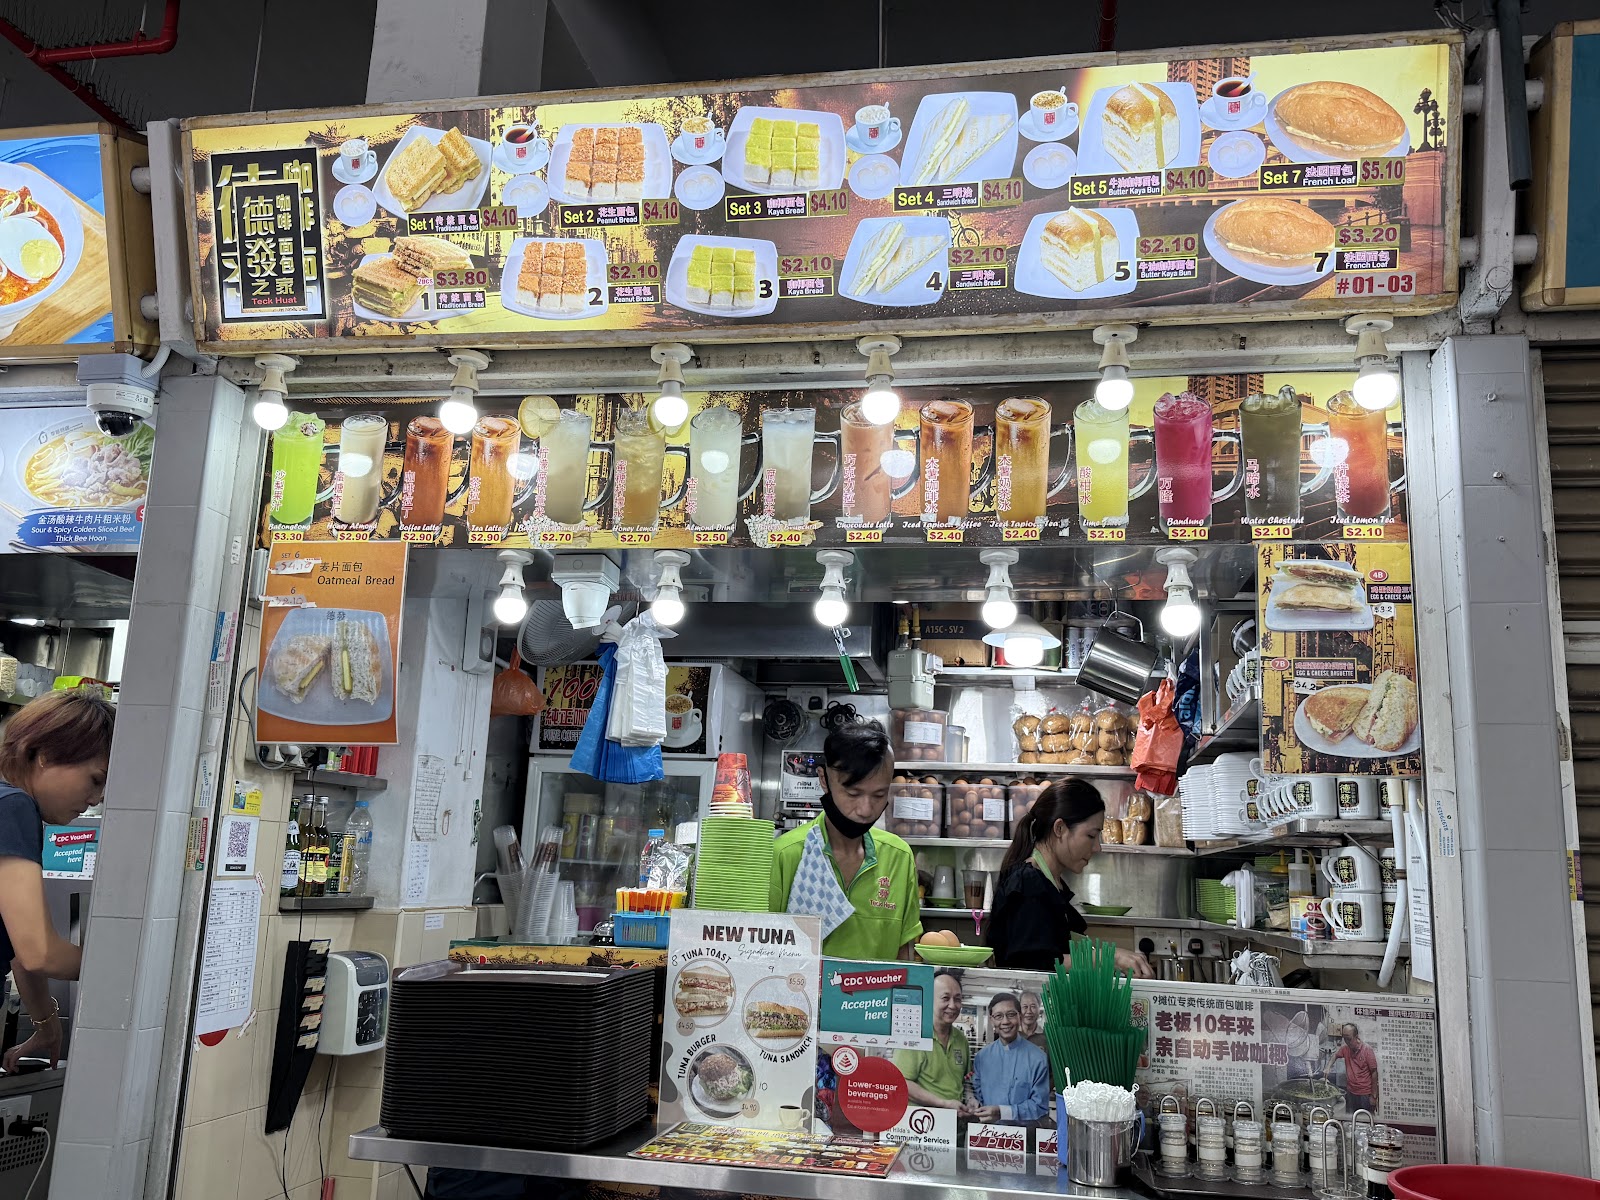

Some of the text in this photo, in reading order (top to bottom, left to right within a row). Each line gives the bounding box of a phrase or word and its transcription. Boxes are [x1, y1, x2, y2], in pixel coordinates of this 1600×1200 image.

[1362, 160, 1403, 181] $5.10
[1167, 169, 1206, 192] $4.10
[1263, 170, 1301, 185] Set 7
[1303, 176, 1356, 186] French Loaf
[942, 187, 973, 198] 三明治
[984, 181, 1021, 202] $4.10
[1073, 180, 1107, 196] Set 5
[1109, 188, 1128, 196] Butter
[811, 192, 847, 212] $4.10
[898, 191, 934, 206] Set 4
[937, 197, 977, 206] Sandwich Bread
[643, 202, 678, 221] $4.10
[730, 201, 761, 216] Set 3
[768, 207, 804, 217] Kaya Bread
[483, 208, 516, 227] $4.10
[564, 210, 594, 224] Set 2
[597, 216, 637, 225] Peanut Bread
[410, 218, 433, 230] Set 1
[1339, 227, 1397, 245] $3.20
[1140, 237, 1195, 254] $2.10
[951, 248, 1004, 264] $2.10
[782, 257, 831, 273] $2.10
[1314, 252, 1329, 273] 7
[610, 265, 658, 280] $2.10
[1115, 261, 1130, 281] 5
[437, 271, 486, 286] $3.80
[926, 271, 942, 290] 4
[759, 280, 772, 298] 3
[588, 288, 603, 306] 2
[38, 515, 131, 525] 金汤酸辣牛肉片粗米粉
[989, 520, 1008, 528] Iced
[1167, 516, 1204, 528] Bandung
[1241, 516, 1304, 525] Water Chestnut
[1330, 516, 1395, 524] Iced Lemon Tea
[54, 526, 71, 534] Spicy
[119, 525, 135, 533] Beef
[685, 523, 736, 531] Almond Drink
[1254, 528, 1290, 537] $2.10
[1346, 528, 1382, 537] $2.10
[274, 532, 302, 541] $3.30
[339, 532, 368, 541] $2.90
[403, 533, 432, 541] $2.90
[470, 533, 500, 542] $2.90
[542, 533, 571, 542] $2.70
[620, 534, 650, 542] $2.70
[696, 533, 725, 542] $2.50
[770, 533, 800, 542] $2.40
[848, 532, 880, 540] $2.40
[929, 531, 961, 540] $2.40
[1005, 530, 1037, 539] $2.40
[1089, 530, 1123, 539] $2.10
[1171, 528, 1206, 538] $2.10
[317, 576, 395, 585] Oatmeal Bread
[925, 626, 942, 634] A15C
[54, 848, 83, 857] Accepted
[703, 925, 796, 945] NEW TUNA
[682, 948, 732, 964] TUNA TOAST
[844, 975, 902, 986] CDC Voucher
[841, 997, 888, 1010] Accepted
[1153, 996, 1254, 1011] 9摊位专卖传统面包咖啡
[865, 1011, 888, 1020] here
[1155, 1010, 1255, 1036] 老板10年来
[759, 1049, 778, 1063] TUNA
[780, 1035, 813, 1064] SANDWICH
[678, 1034, 717, 1079] TUNA BURGER
[848, 1080, 897, 1092] Lower-sugar
[848, 1089, 888, 1099] beverages
[885, 1133, 922, 1143] Community
[923, 1136, 950, 1144] Services
[987, 1138, 1021, 1149] PLUS
